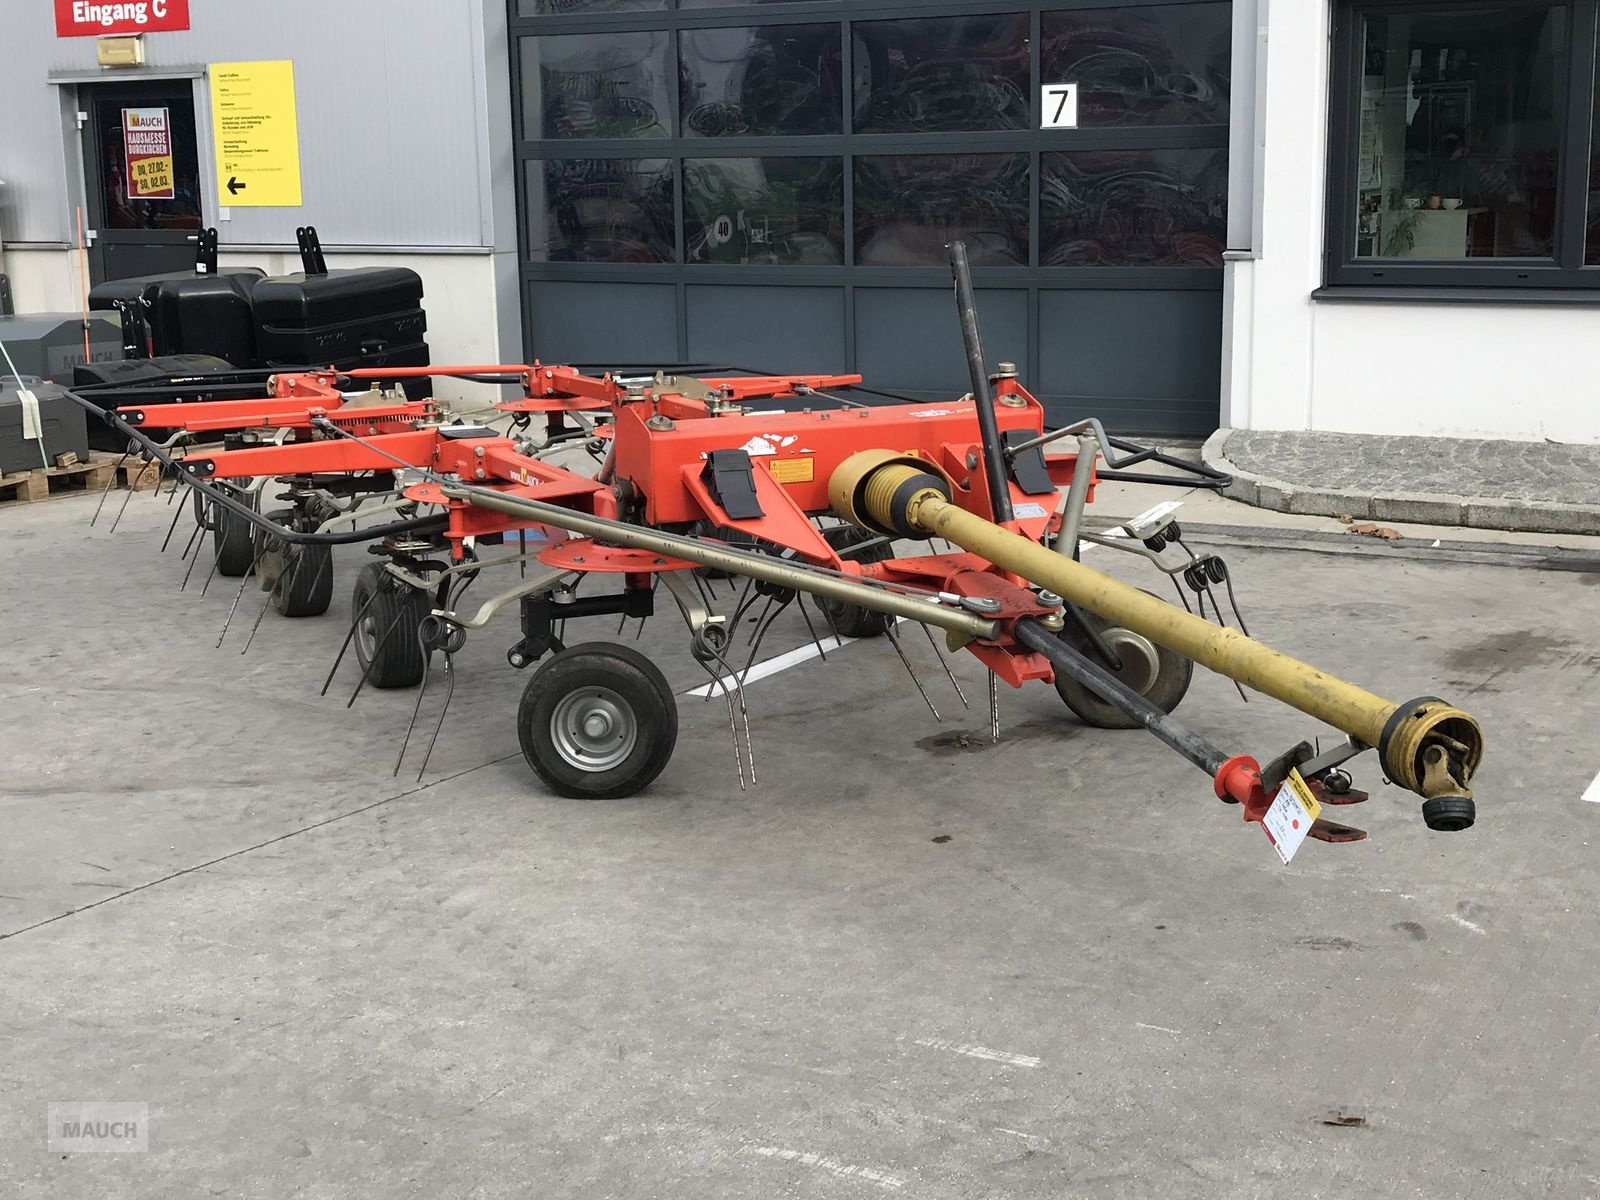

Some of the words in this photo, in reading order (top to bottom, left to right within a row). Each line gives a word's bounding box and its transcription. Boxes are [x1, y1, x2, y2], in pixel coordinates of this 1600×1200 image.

[72, 1, 148, 26] Eingang
[152, 0, 167, 18] C
[1049, 90, 1069, 124] 7
[132, 117, 162, 127] MAUCH
[127, 132, 167, 144] HAUSMESSE
[718, 221, 729, 237] 40
